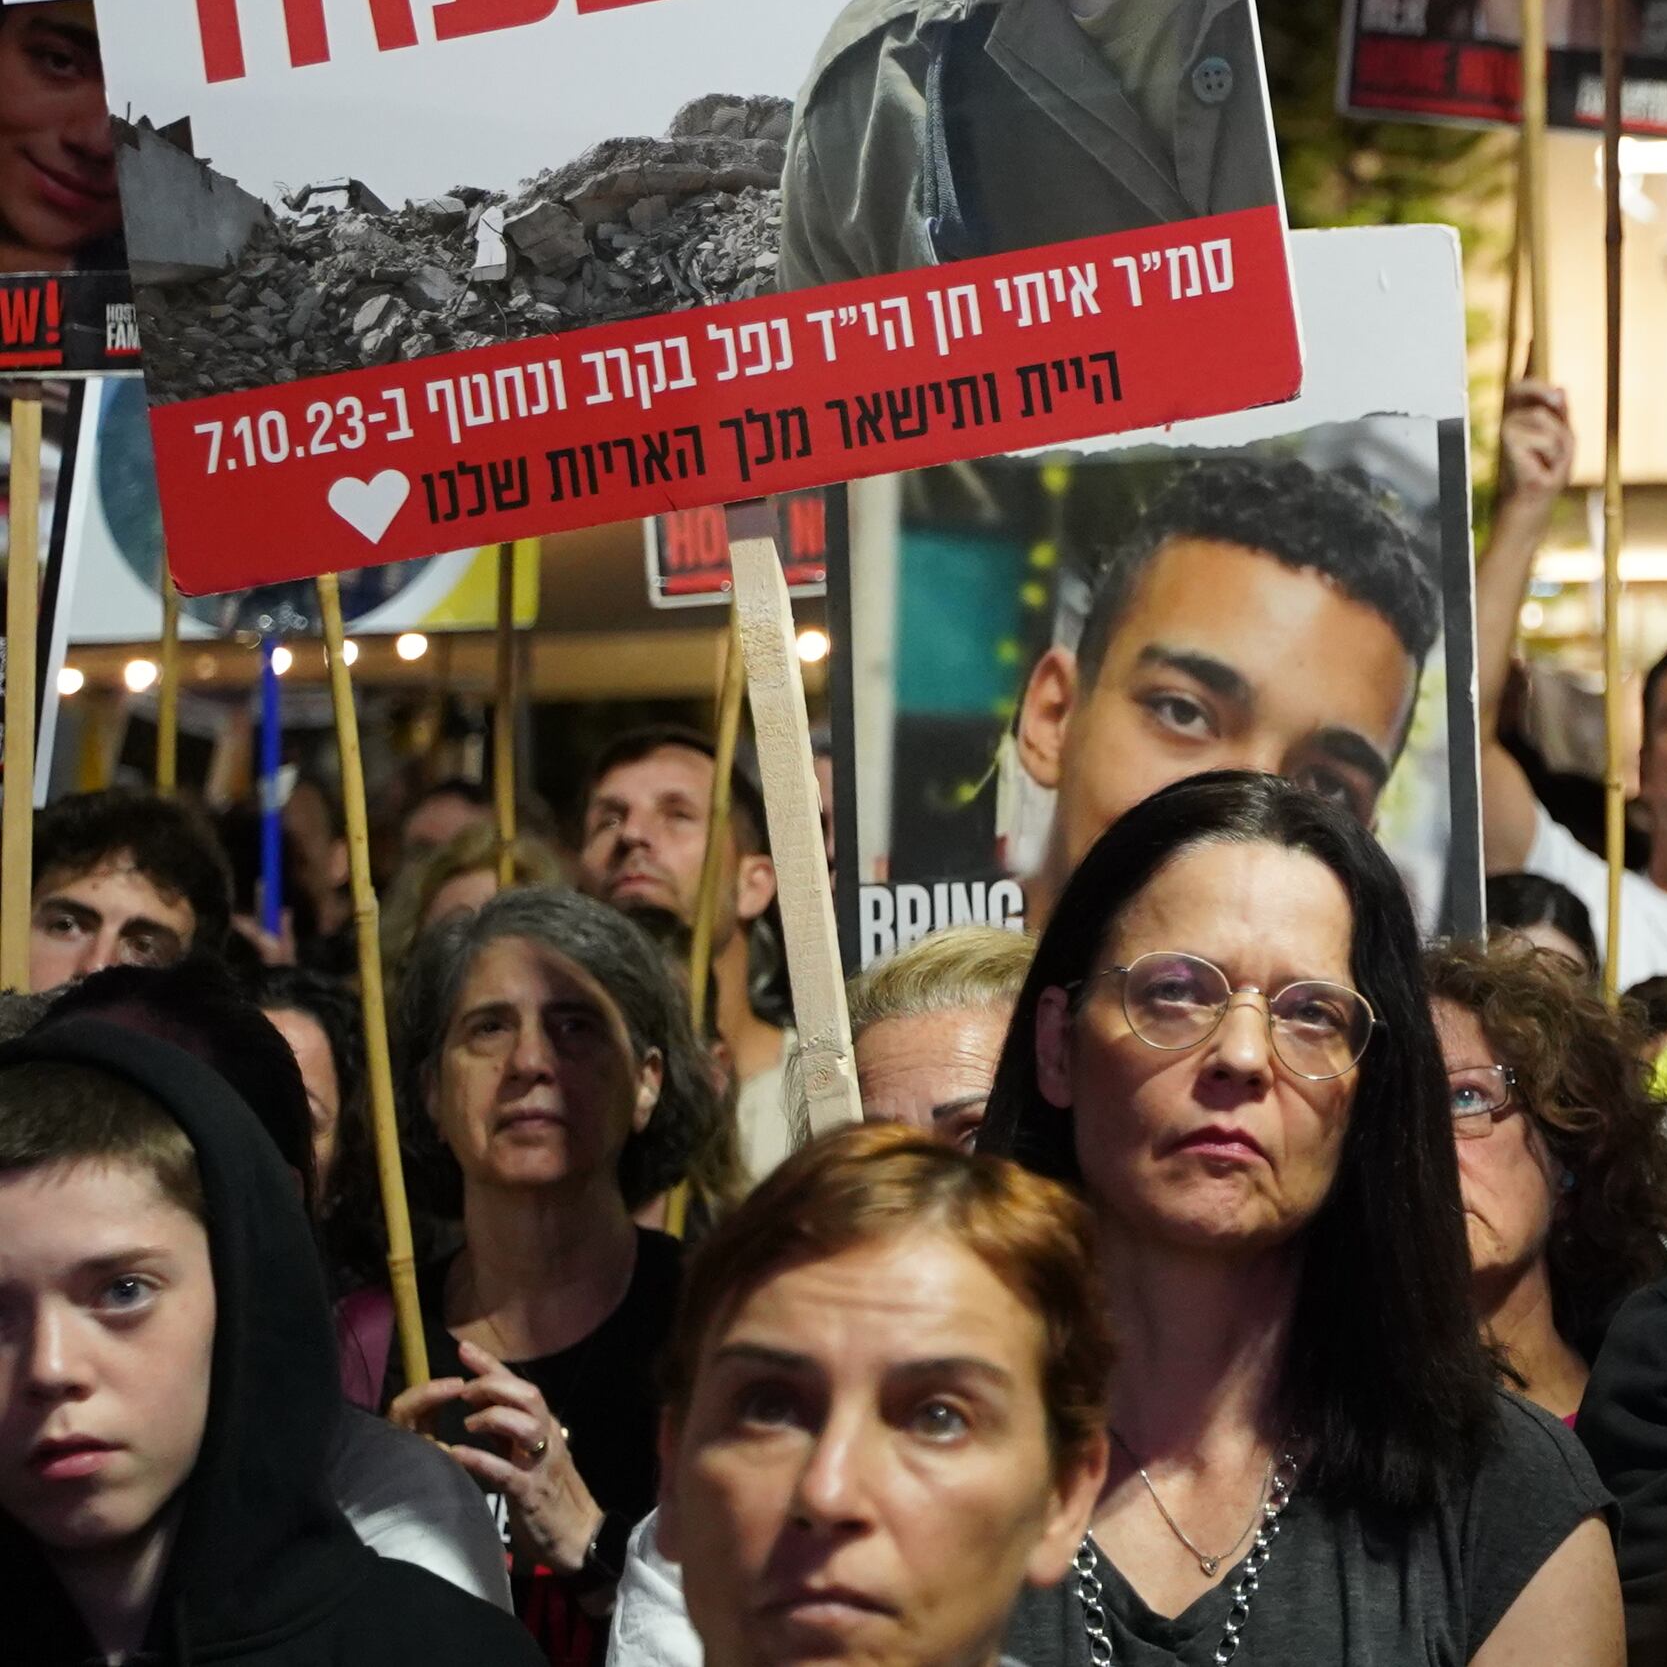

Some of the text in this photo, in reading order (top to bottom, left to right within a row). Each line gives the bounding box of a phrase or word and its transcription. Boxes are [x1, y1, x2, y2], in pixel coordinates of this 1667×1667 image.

[994, 263, 1101, 327] איתי
[1112, 238, 1235, 307] סמ"ר
[708, 317, 794, 382] נפל
[806, 297, 915, 362] הי"ד
[927, 285, 982, 356] חן
[427, 359, 567, 444] ונחטף
[582, 337, 697, 411] בקרב
[421, 350, 1122, 524] היית ותישאר מלך האריות שלנו
